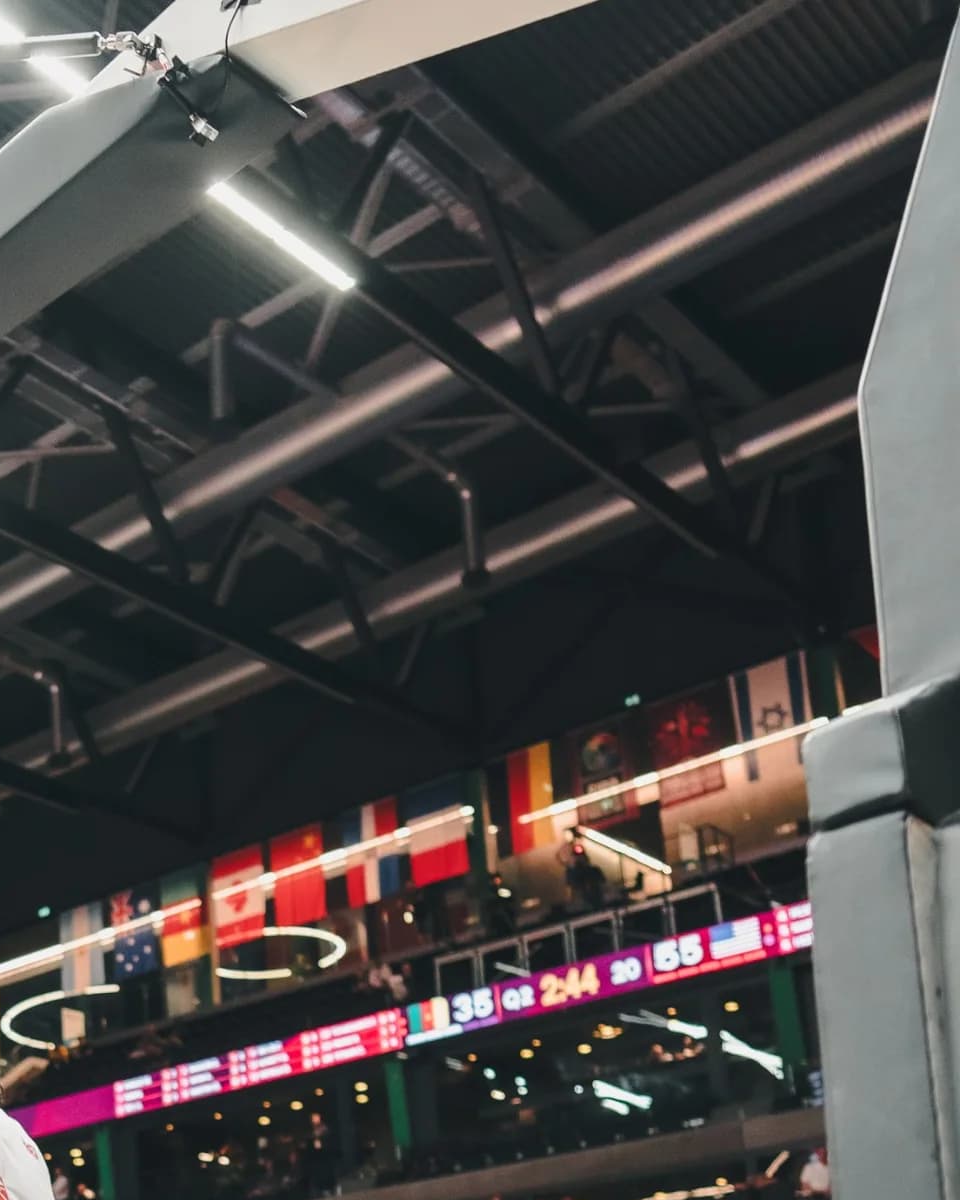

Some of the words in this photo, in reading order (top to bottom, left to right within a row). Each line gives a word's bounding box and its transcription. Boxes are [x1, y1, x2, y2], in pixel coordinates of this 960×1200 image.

[451, 987, 494, 1023] 35
[539, 963, 601, 1008] 2:44
[653, 933, 704, 972] 55
